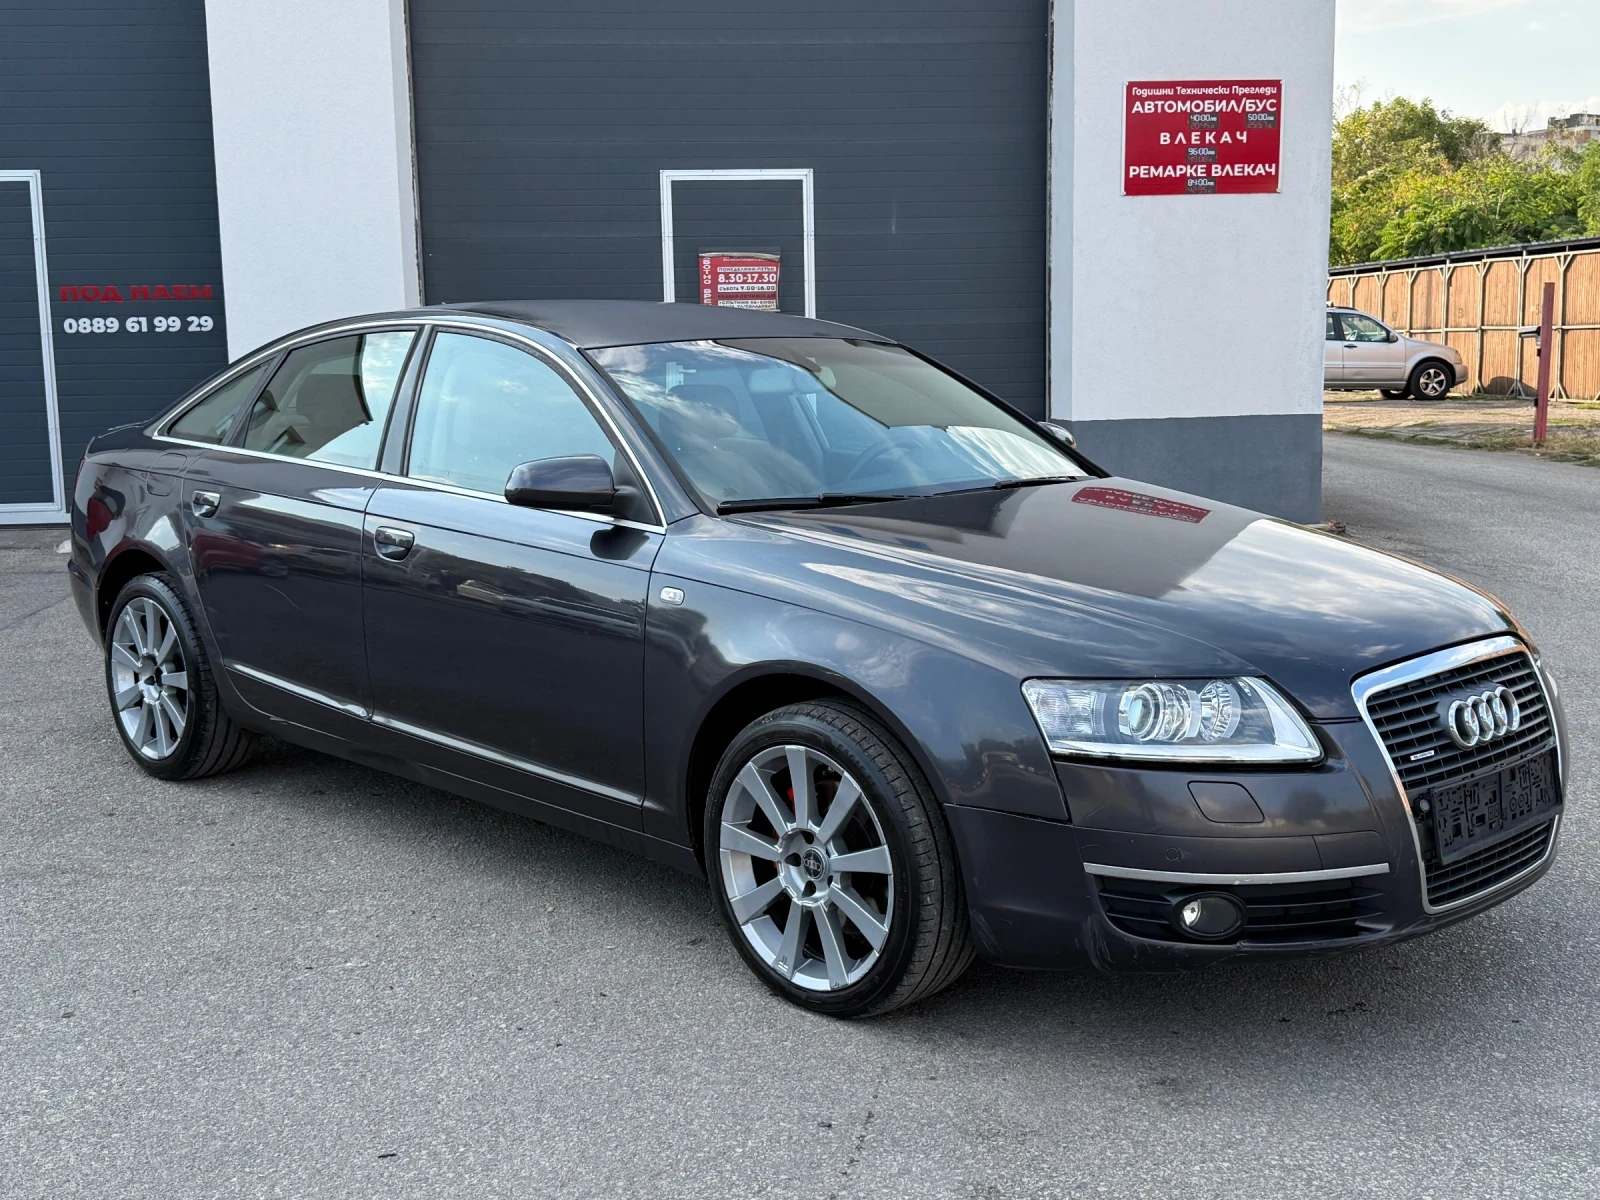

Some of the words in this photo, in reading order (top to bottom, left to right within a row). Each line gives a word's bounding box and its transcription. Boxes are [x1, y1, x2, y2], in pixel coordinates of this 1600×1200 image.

[1132, 87, 1174, 97] Годишни
[1176, 86, 1230, 95] Технически
[1232, 85, 1277, 96] Прегледи
[1132, 97, 1277, 114] АВТОМОБИЛ/БУС
[1160, 131, 1247, 145] ВЛЕКАЧ
[1129, 165, 1207, 178] РЕМАРКЕ
[1211, 163, 1276, 177] ВЛЕКАЧ
[718, 274, 776, 282] 8.30-17.30
[60, 285, 124, 304] ПОД
[130, 284, 213, 301] НАЕМ
[63, 317, 120, 334] 0889
[125, 316, 148, 333] 61
[153, 316, 182, 333] 99
[186, 315, 214, 332] 29
